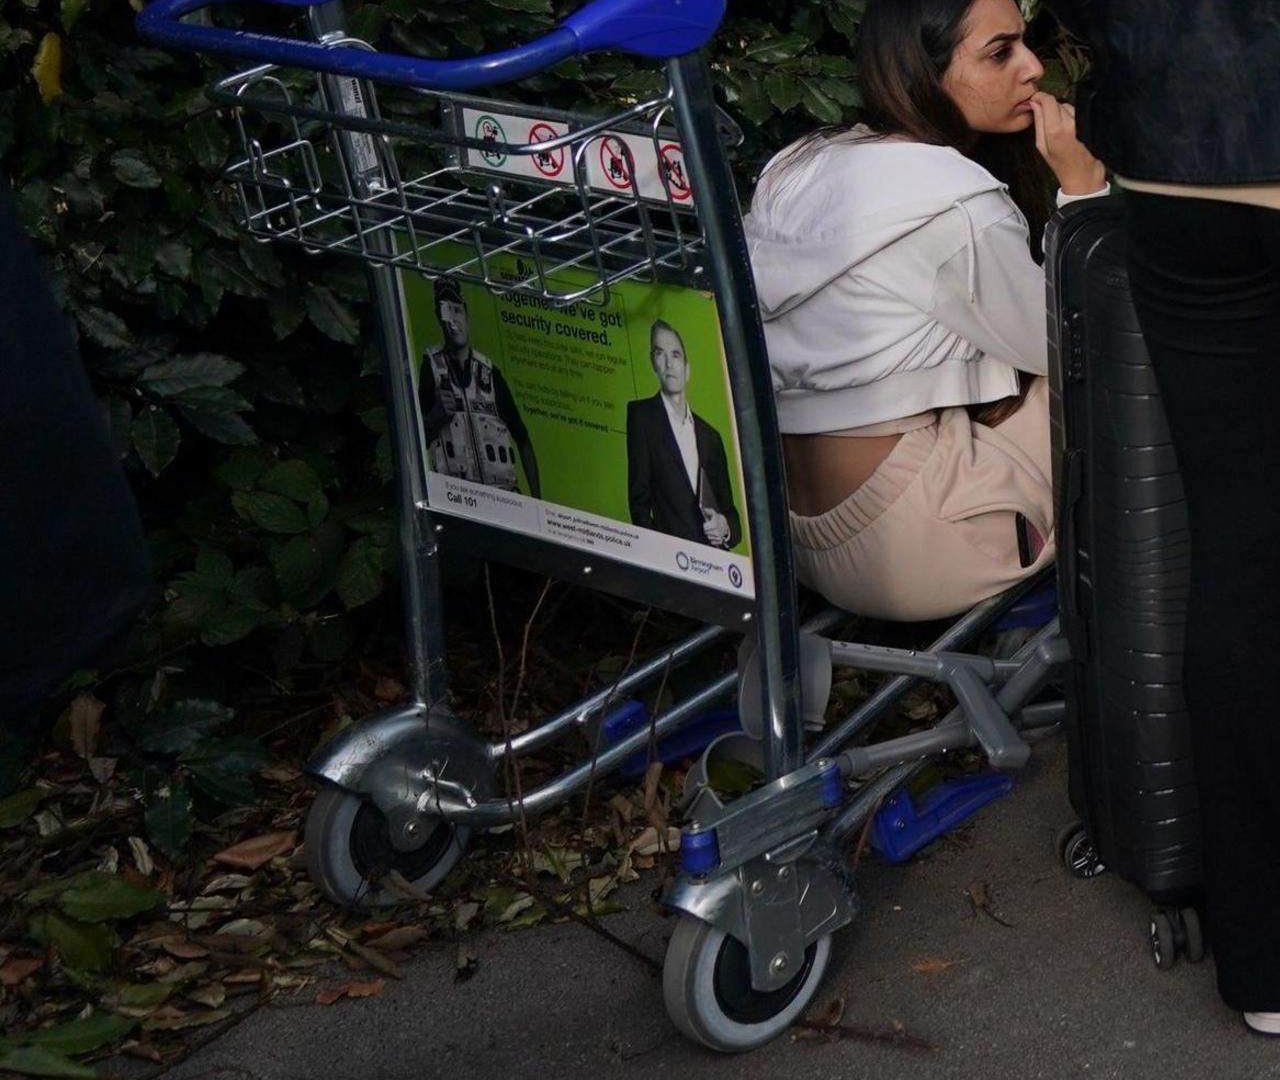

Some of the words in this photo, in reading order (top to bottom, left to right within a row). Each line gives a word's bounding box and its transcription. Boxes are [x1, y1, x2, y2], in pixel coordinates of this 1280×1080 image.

[600, 311, 623, 328] got
[501, 310, 551, 334] security
[555, 321, 612, 347] covered.
[447, 491, 462, 504] Call
[464, 496, 478, 508] 101
